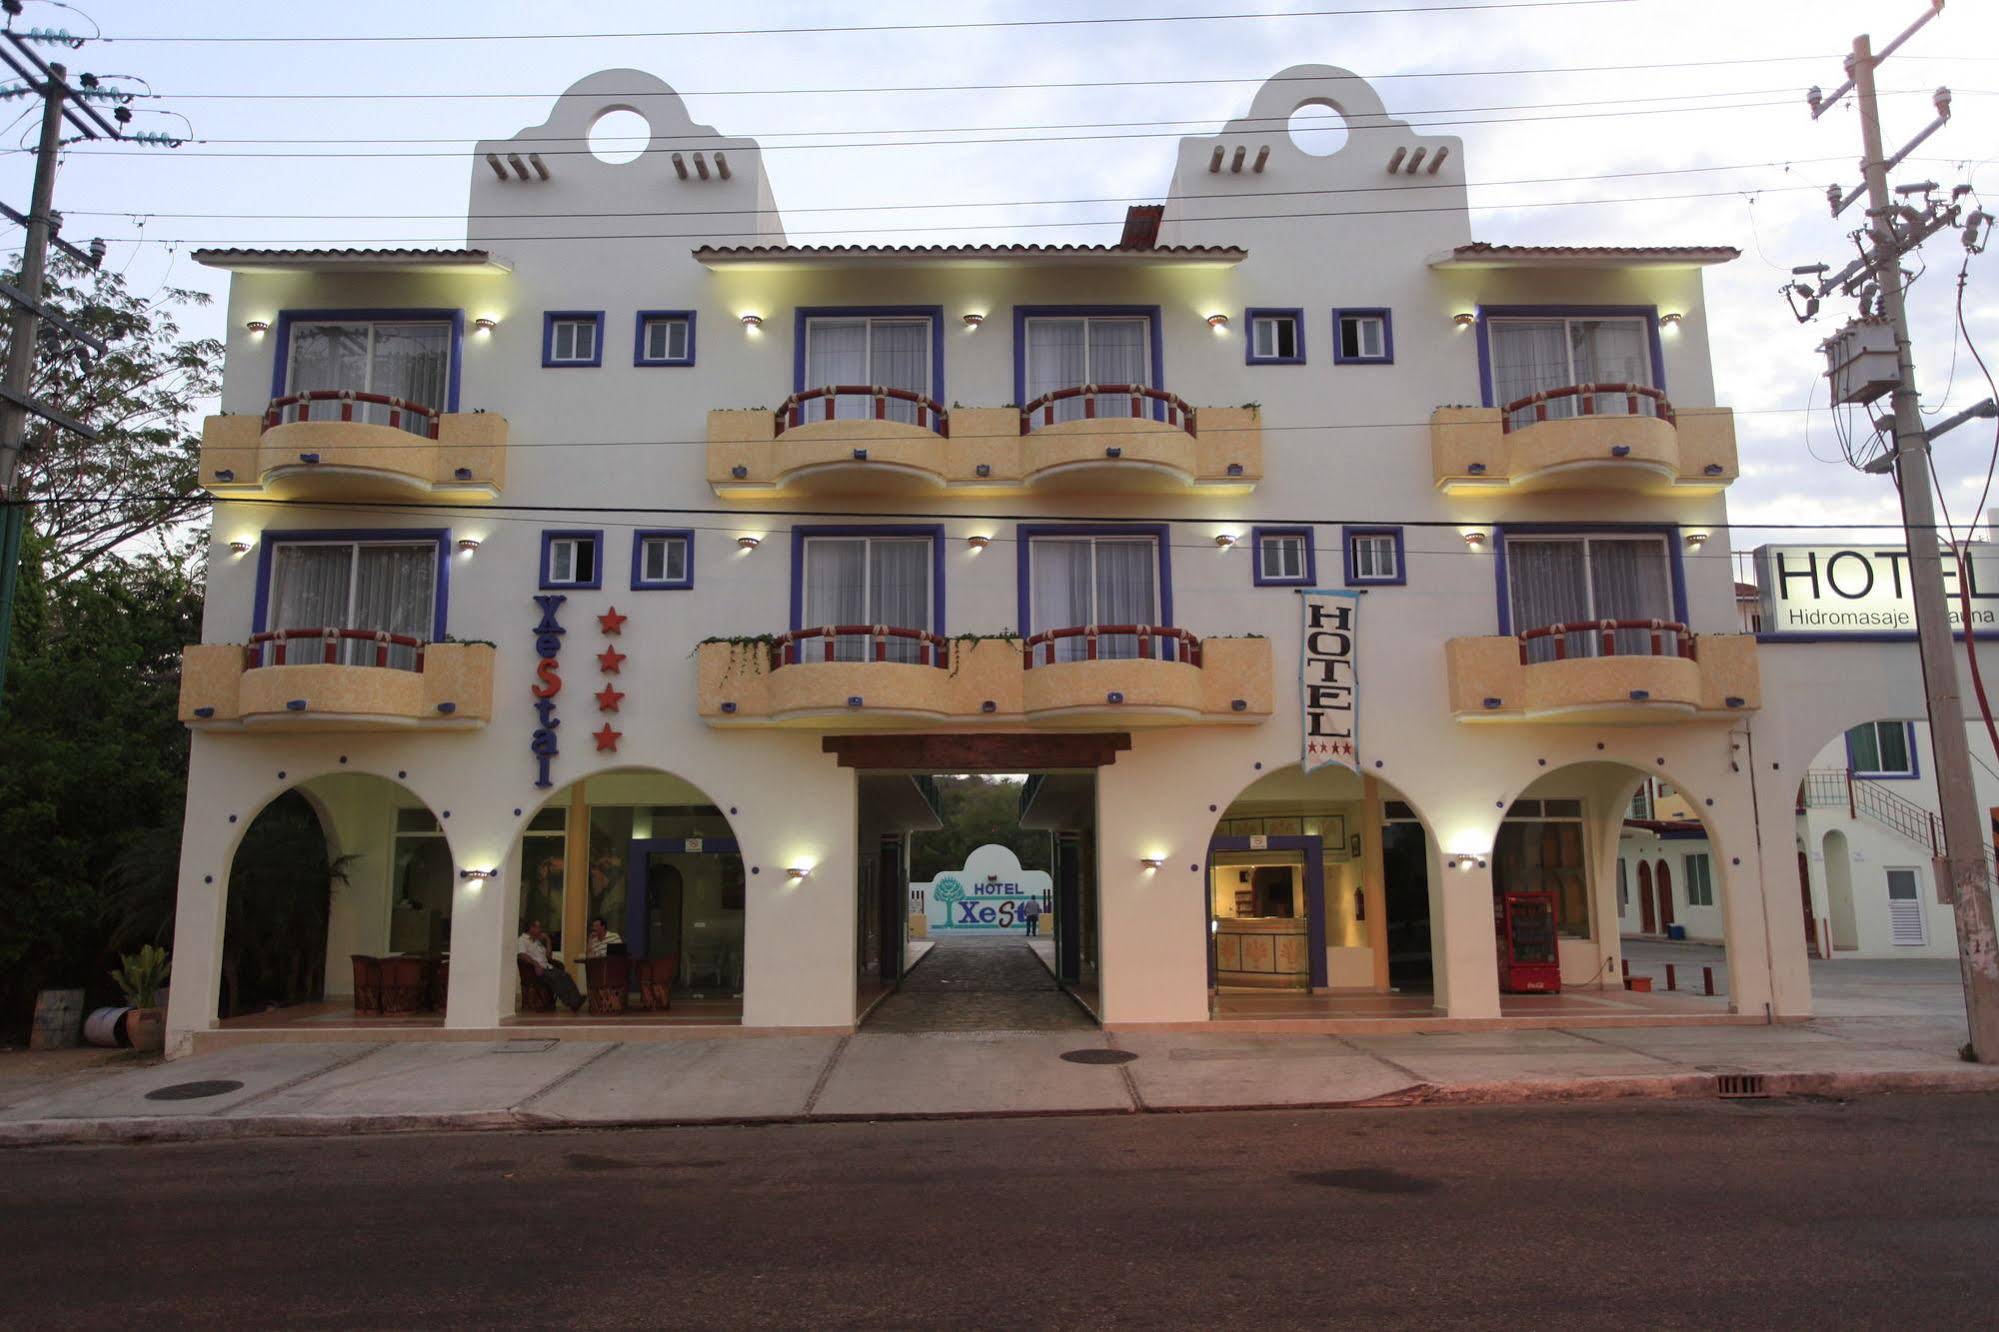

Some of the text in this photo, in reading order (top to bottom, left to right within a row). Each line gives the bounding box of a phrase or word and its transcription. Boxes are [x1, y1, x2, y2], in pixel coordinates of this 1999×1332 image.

[1789, 609, 1995, 629] Hidromasaje ana
[1307, 604, 1352, 738] HOTEL
[974, 883, 1024, 895] HOTEL
[958, 901, 1027, 928] XeSt
